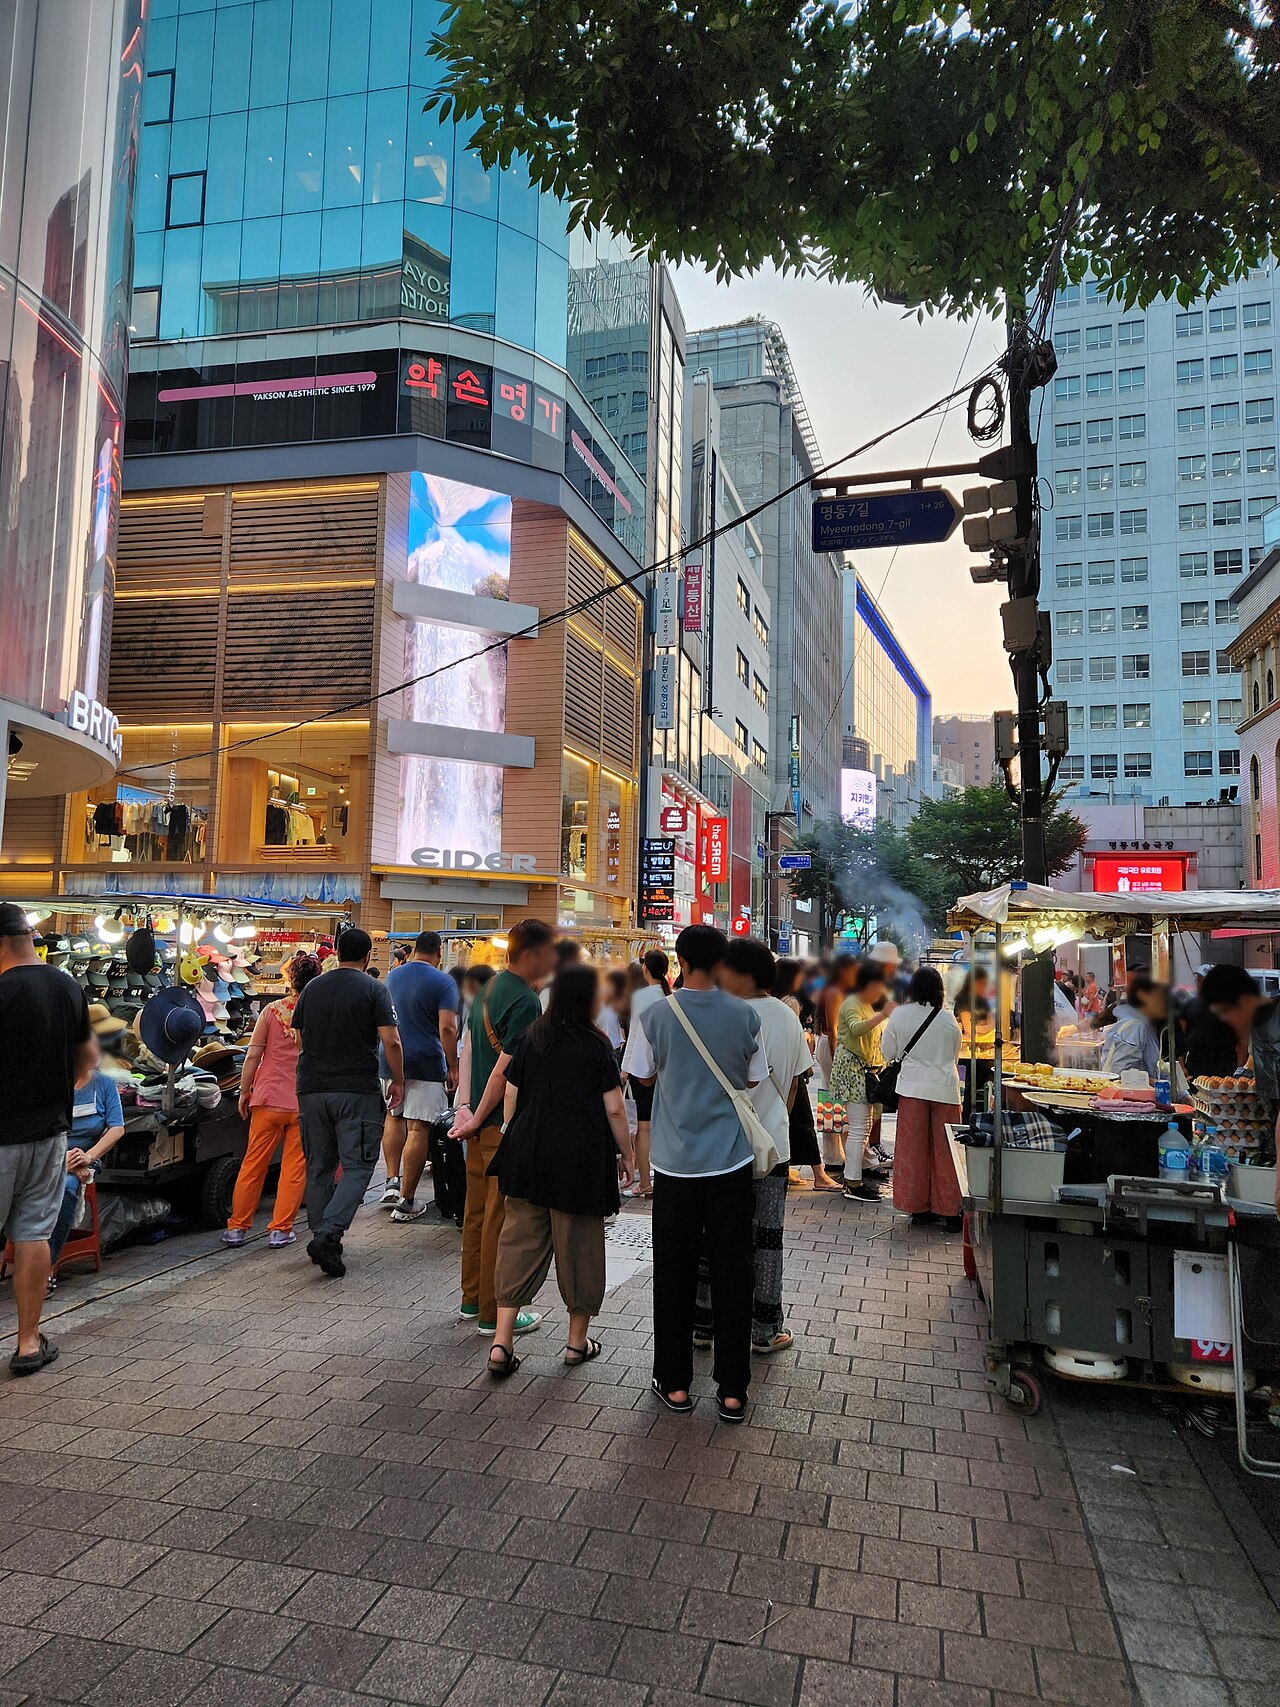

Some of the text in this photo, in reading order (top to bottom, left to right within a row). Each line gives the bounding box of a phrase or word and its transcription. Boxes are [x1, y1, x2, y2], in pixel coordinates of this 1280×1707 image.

[253, 383, 376, 401] YAKSON AESTHETIC SINCE 1979
[405, 357, 561, 433] 약손명가
[821, 502, 869, 520] 명동7길
[934, 501, 944, 509] 26
[820, 518, 911, 535] Myeongdong 7-gil
[686, 575, 700, 617] 부동산
[1109, 841, 1174, 850] 명동예술극장
[411, 847, 537, 873] EIDER
